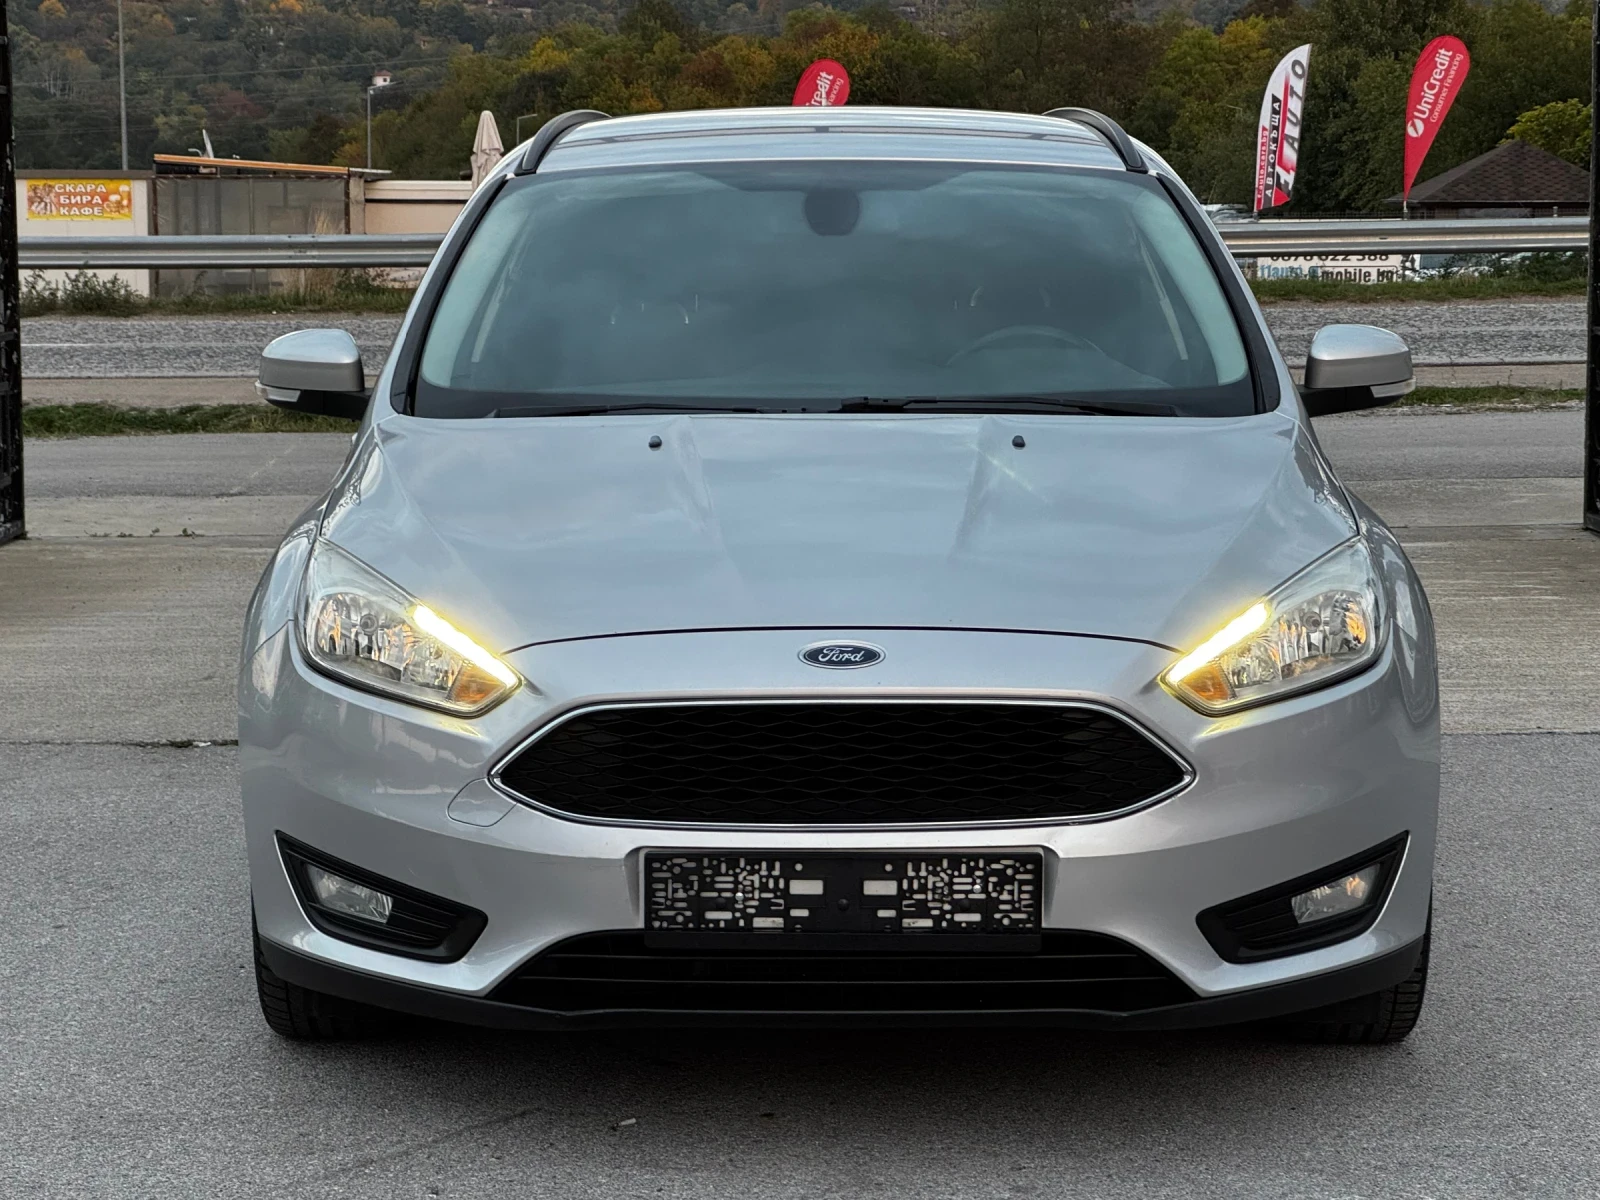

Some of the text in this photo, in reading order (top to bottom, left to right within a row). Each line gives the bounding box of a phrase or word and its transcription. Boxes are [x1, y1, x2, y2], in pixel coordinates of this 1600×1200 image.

[1413, 47, 1453, 119] UniCredit
[1430, 53, 1464, 123] Consumer Financing
[1284, 59, 1306, 154] AUTO
[1265, 102, 1281, 198] АВТОКЪЩА
[54, 183, 107, 193] СКАРА
[59, 195, 103, 205] БИРА
[59, 206, 104, 216] КАФЕ
[818, 646, 865, 662] Ford
